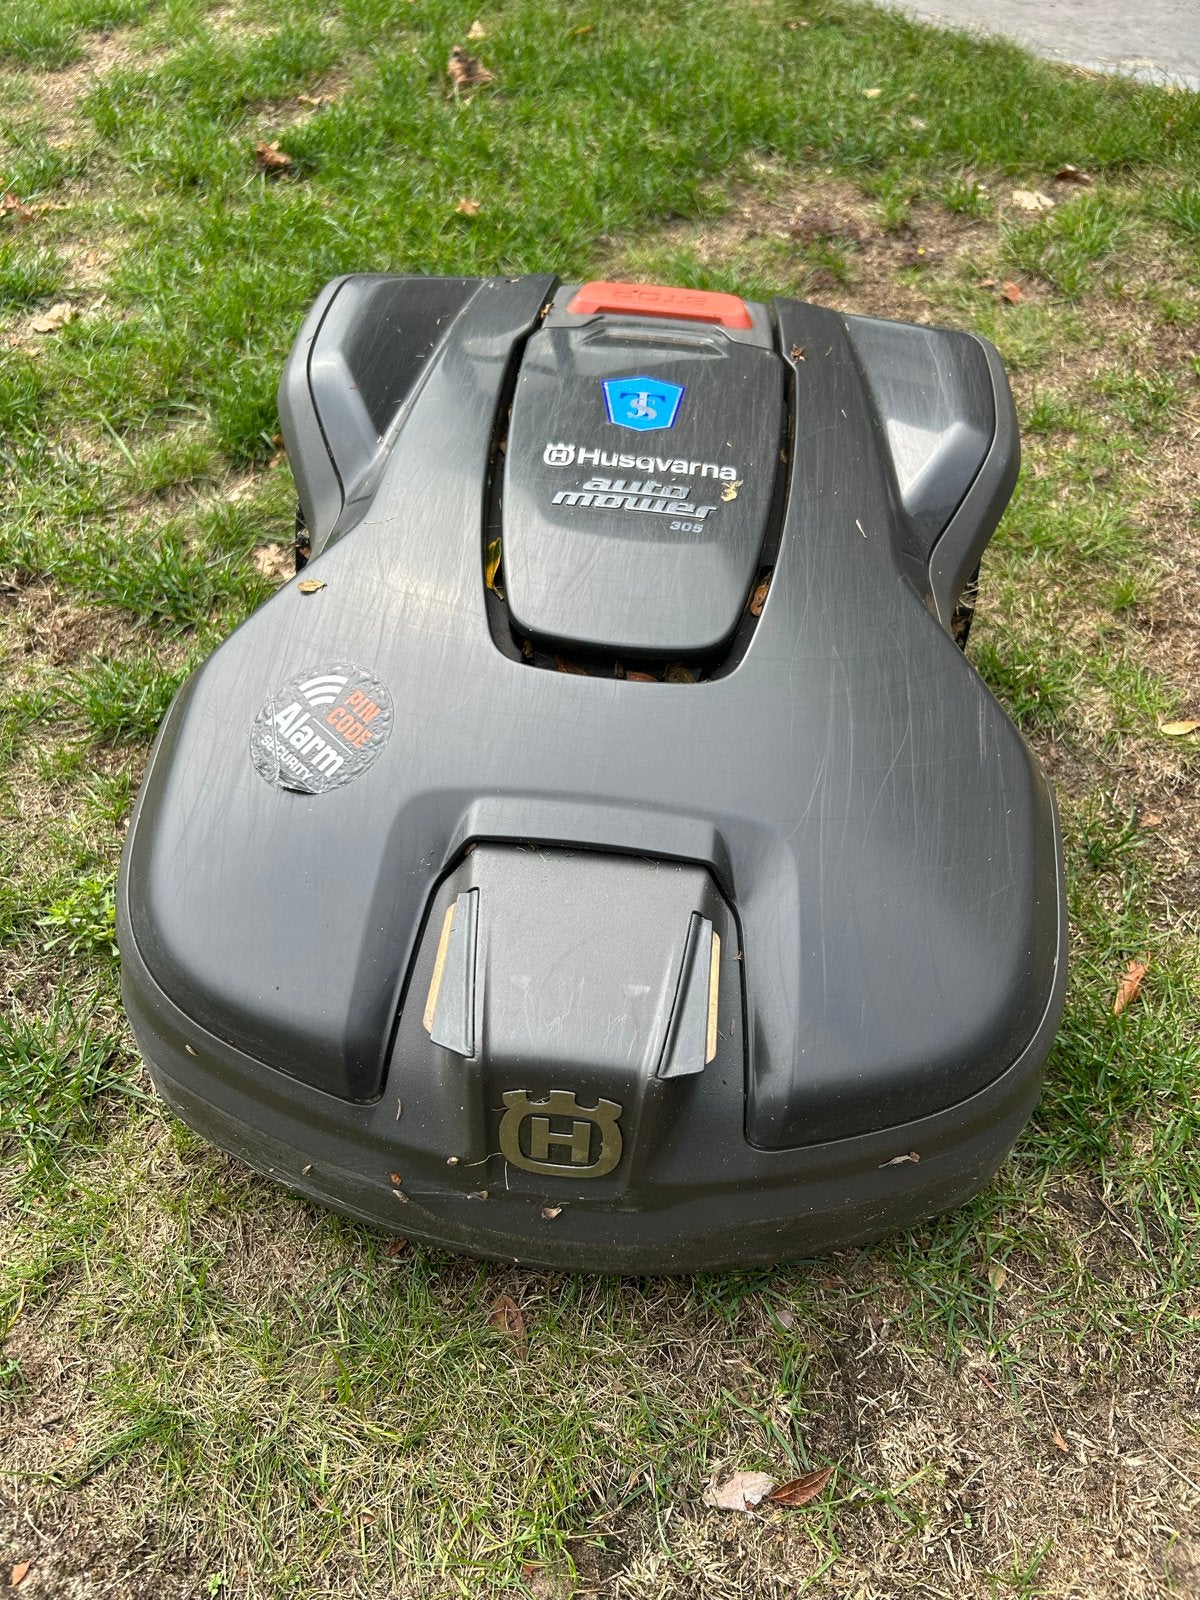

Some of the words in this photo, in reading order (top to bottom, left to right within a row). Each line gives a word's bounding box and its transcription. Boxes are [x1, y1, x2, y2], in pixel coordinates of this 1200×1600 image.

[577, 447, 737, 480] Husqvarna
[551, 491, 718, 519] mower
[583, 477, 690, 500] auto
[669, 521, 704, 533] 305
[345, 688, 381, 724] PIN
[265, 702, 345, 778] Alarm
[326, 706, 373, 749] CODE
[261, 735, 314, 781] SECURITY
